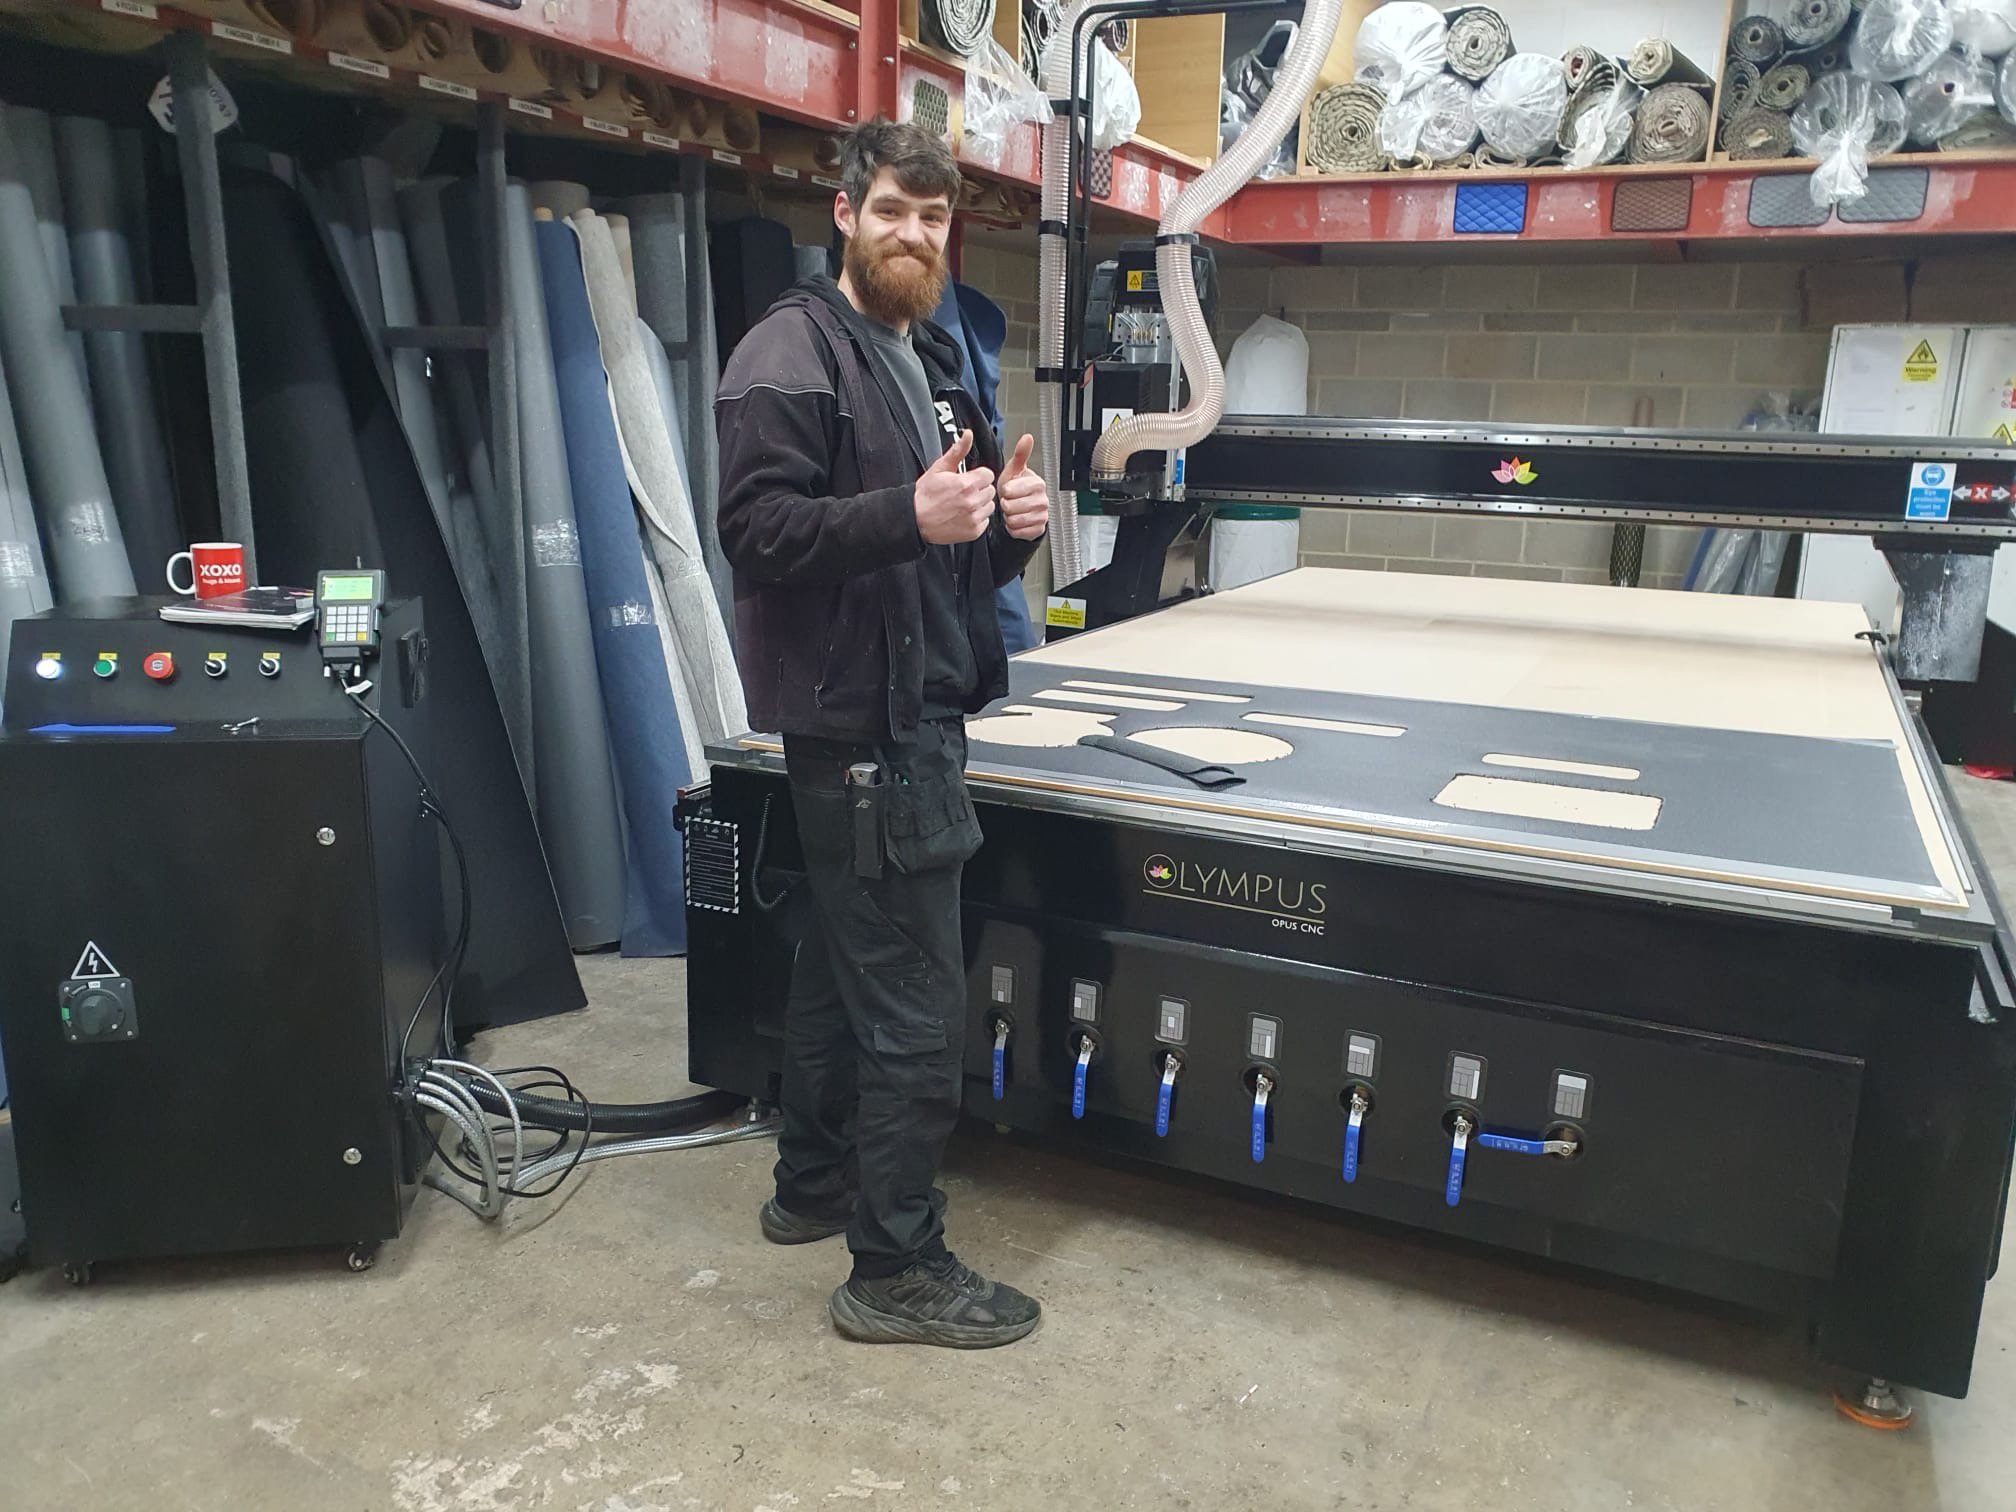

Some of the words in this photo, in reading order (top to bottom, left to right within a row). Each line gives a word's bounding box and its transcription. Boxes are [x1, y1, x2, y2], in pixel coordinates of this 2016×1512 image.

[1975, 487, 1989, 499] X
[199, 563, 241, 577] XOXO
[1143, 853, 1327, 914] OLYMPUS
[1271, 918, 1298, 931] OPUS
[1300, 923, 1325, 936] CNC
